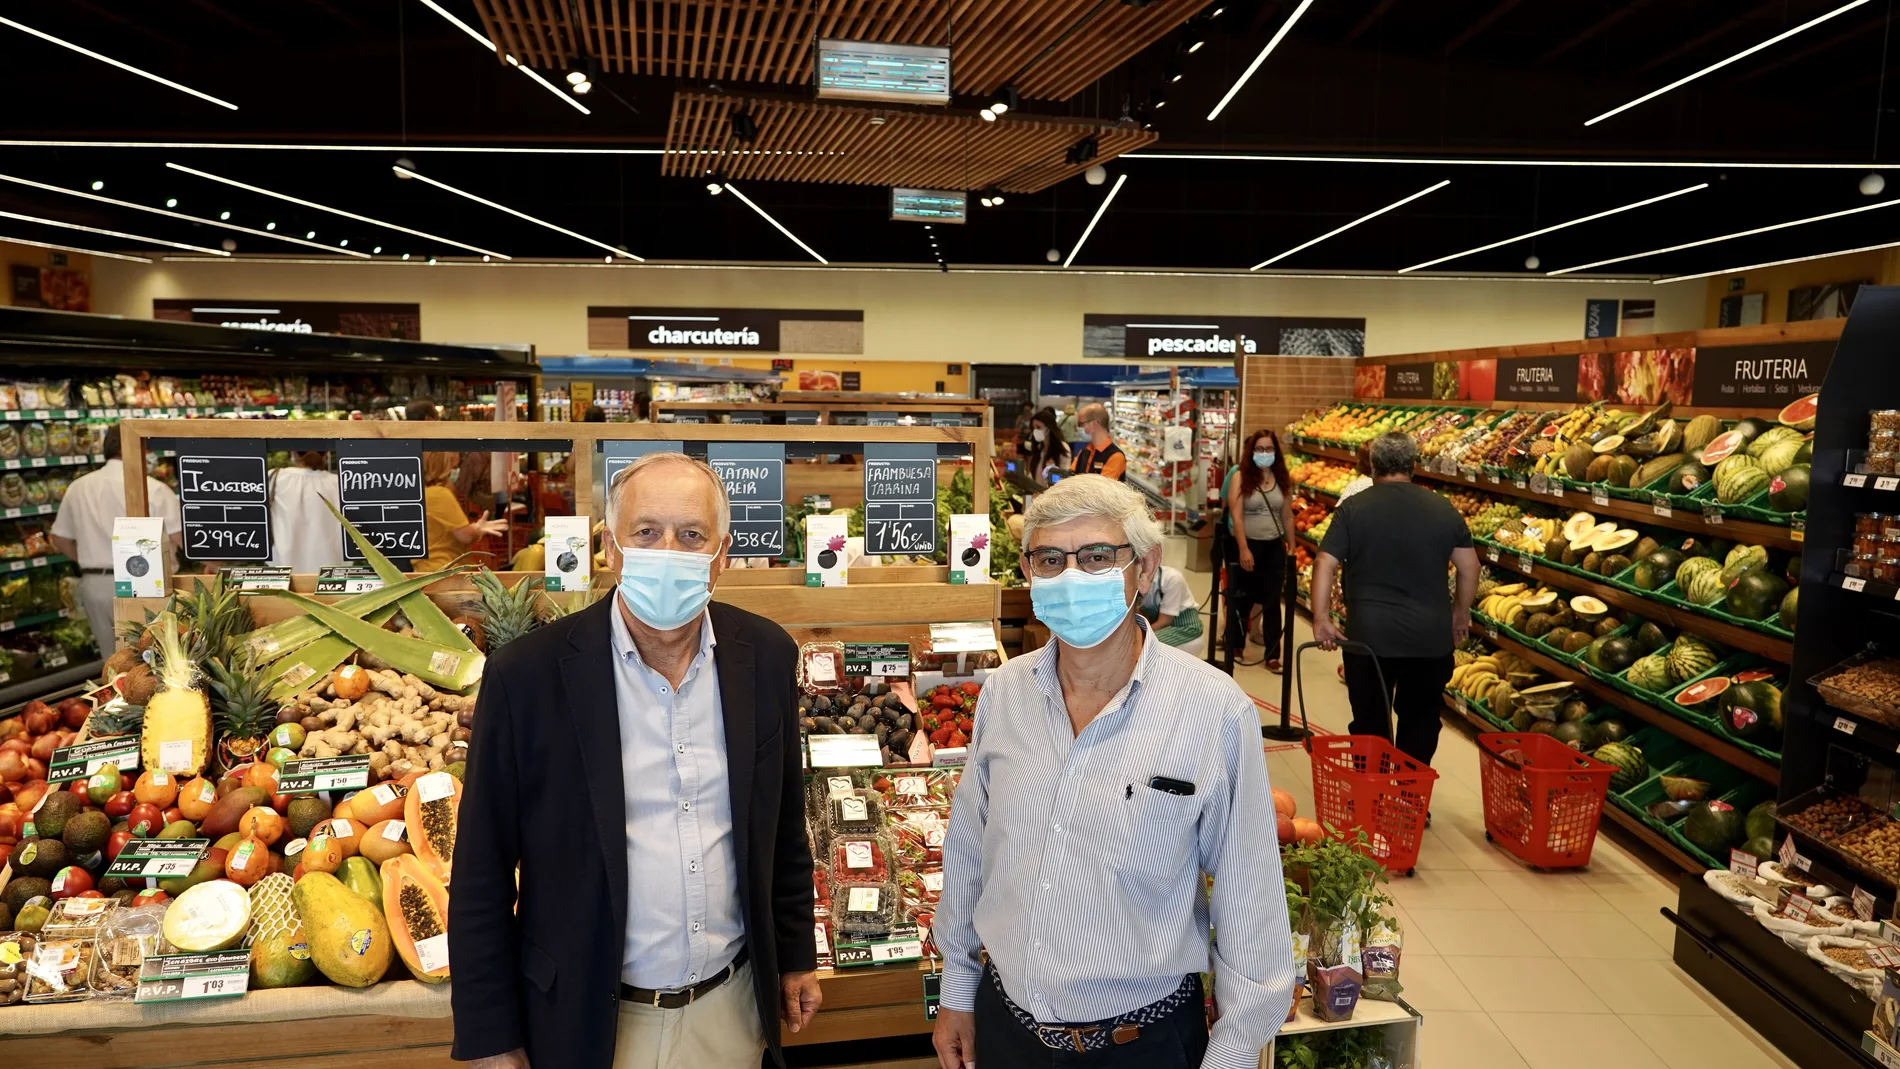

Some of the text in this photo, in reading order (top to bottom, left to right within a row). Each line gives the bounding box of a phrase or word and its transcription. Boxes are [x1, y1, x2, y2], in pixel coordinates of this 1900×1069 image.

[1588, 304, 1600, 337] BAZAR
[648, 325, 760, 345] charcutería
[1516, 367, 1554, 382] FRUTERIA
[1734, 358, 1808, 380] FRUTERIA
[714, 467, 769, 480] PLATANO
[868, 467, 931, 481] FRAMBUESA
[182, 470, 264, 493] JENGIBRE
[341, 470, 416, 492] PAPAYON
[724, 481, 757, 495] REIR
[871, 481, 920, 495] TARRINA
[318, 583, 345, 591] P.V.P.
[845, 664, 869, 672] P.V.P.
[51, 767, 83, 779] P.V.P.
[280, 780, 313, 789] P.V.P.
[111, 862, 141, 871] P.V.P.
[840, 946, 904, 961] P.V.P. 1'95
[141, 979, 224, 997] P.V.P. 1'03
